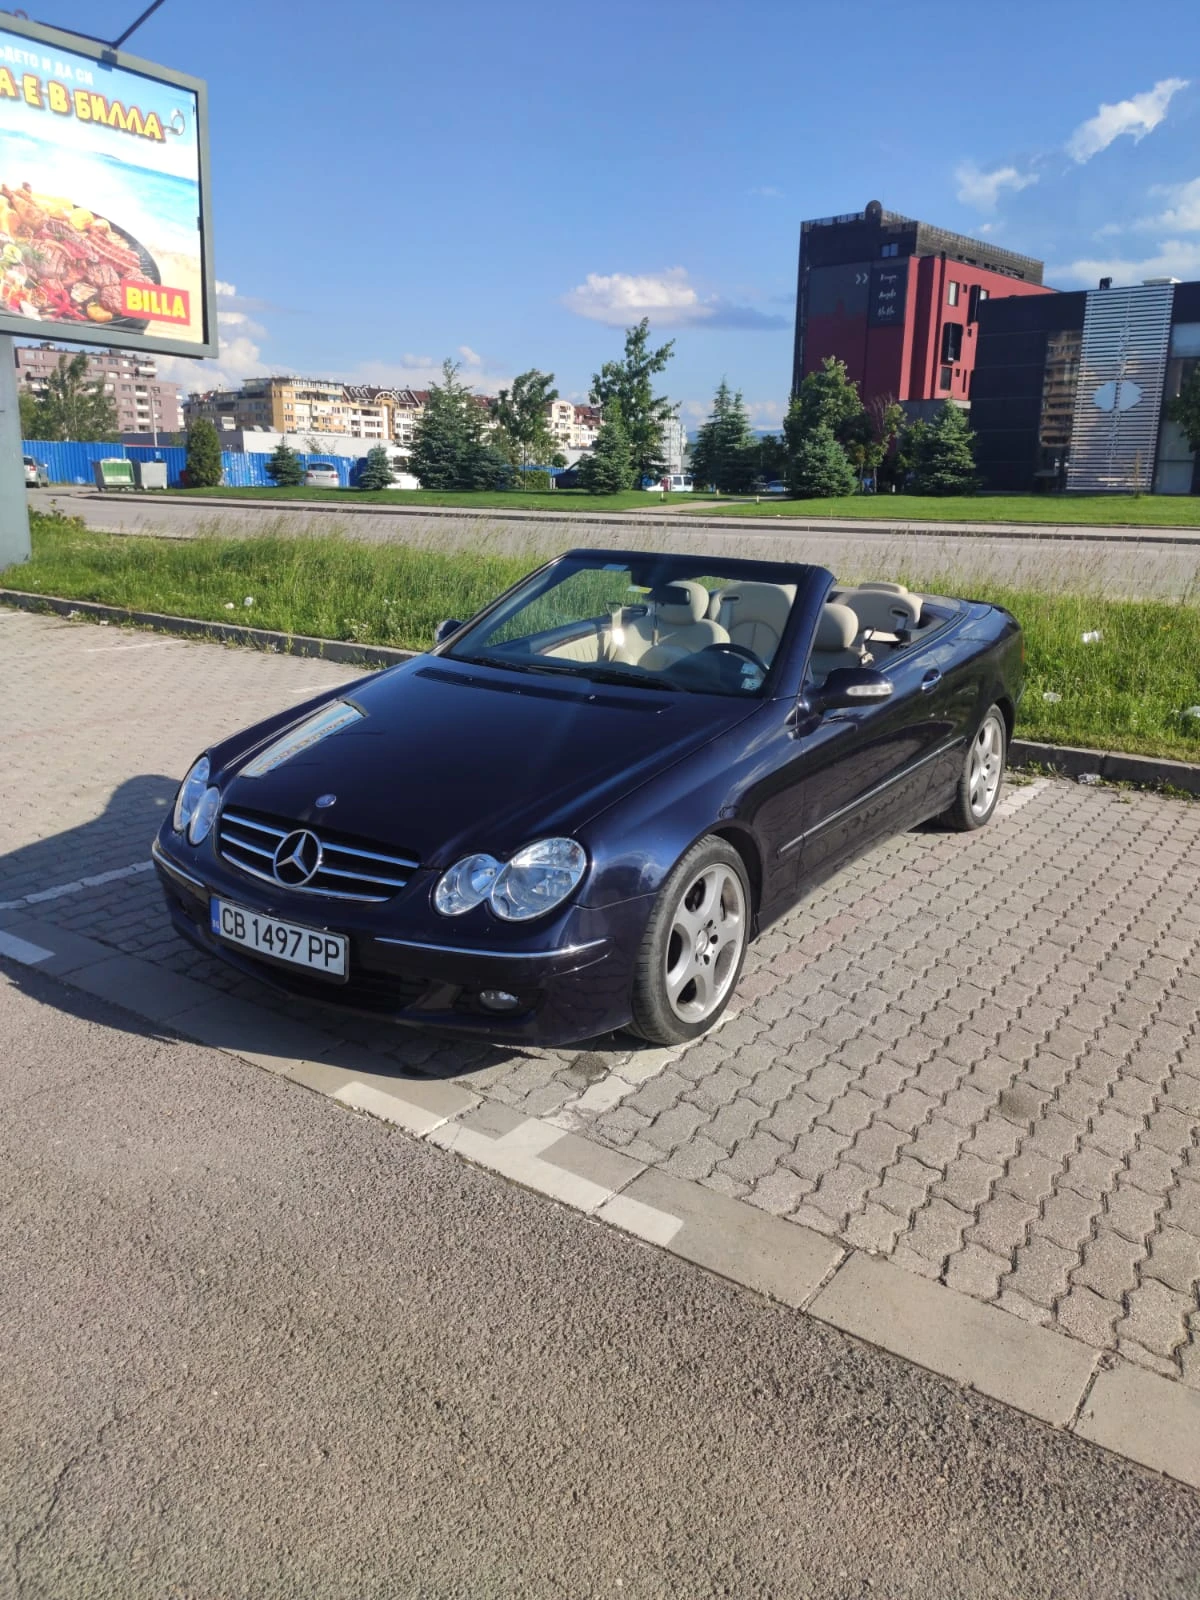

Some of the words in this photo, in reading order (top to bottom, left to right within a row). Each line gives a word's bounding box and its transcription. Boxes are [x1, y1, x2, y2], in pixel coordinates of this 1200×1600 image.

[73, 89, 165, 142] БИЛЛА
[126, 286, 187, 319] BILLA
[222, 907, 246, 940] CB
[252, 918, 303, 958] 1497
[308, 934, 340, 967] PP
